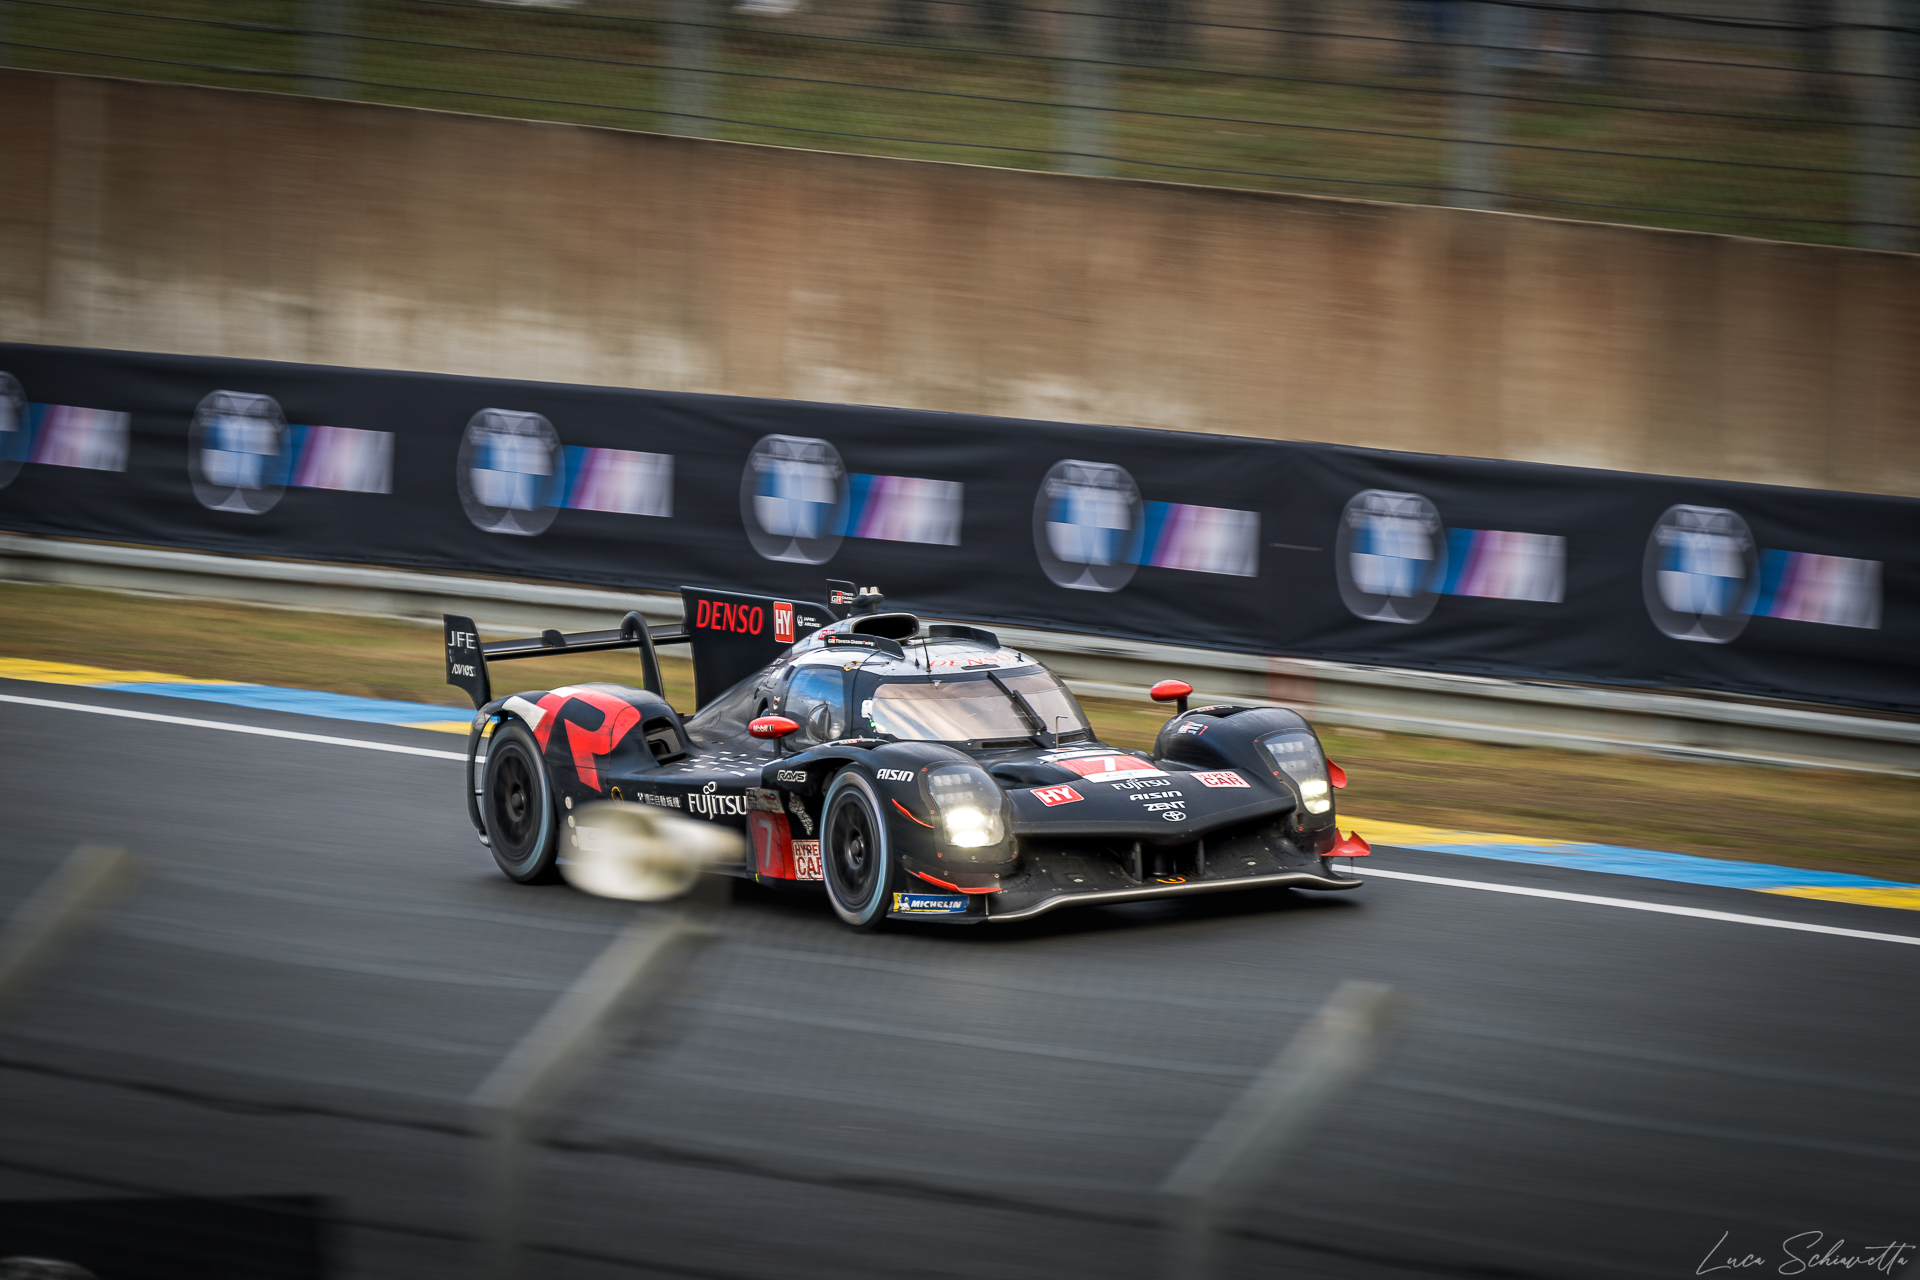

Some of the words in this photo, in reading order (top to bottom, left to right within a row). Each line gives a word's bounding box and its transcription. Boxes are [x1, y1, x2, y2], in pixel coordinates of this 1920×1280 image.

[696, 598, 765, 636] DENSO
[775, 609, 792, 636] HY
[447, 630, 477, 649] JFE
[929, 653, 1011, 667] DENSO
[1083, 756, 1117, 772] 7
[776, 769, 808, 783] RAYS
[876, 768, 915, 782] AISIN
[1204, 777, 1243, 786] CAR
[1111, 779, 1171, 791] FUJITSU
[1036, 787, 1073, 804] HY
[1129, 790, 1182, 801] AISIN
[687, 790, 748, 820] FUJITSU
[1143, 801, 1186, 812] ZENT
[757, 818, 773, 868] 7
[911, 900, 962, 909] MICHELIN
